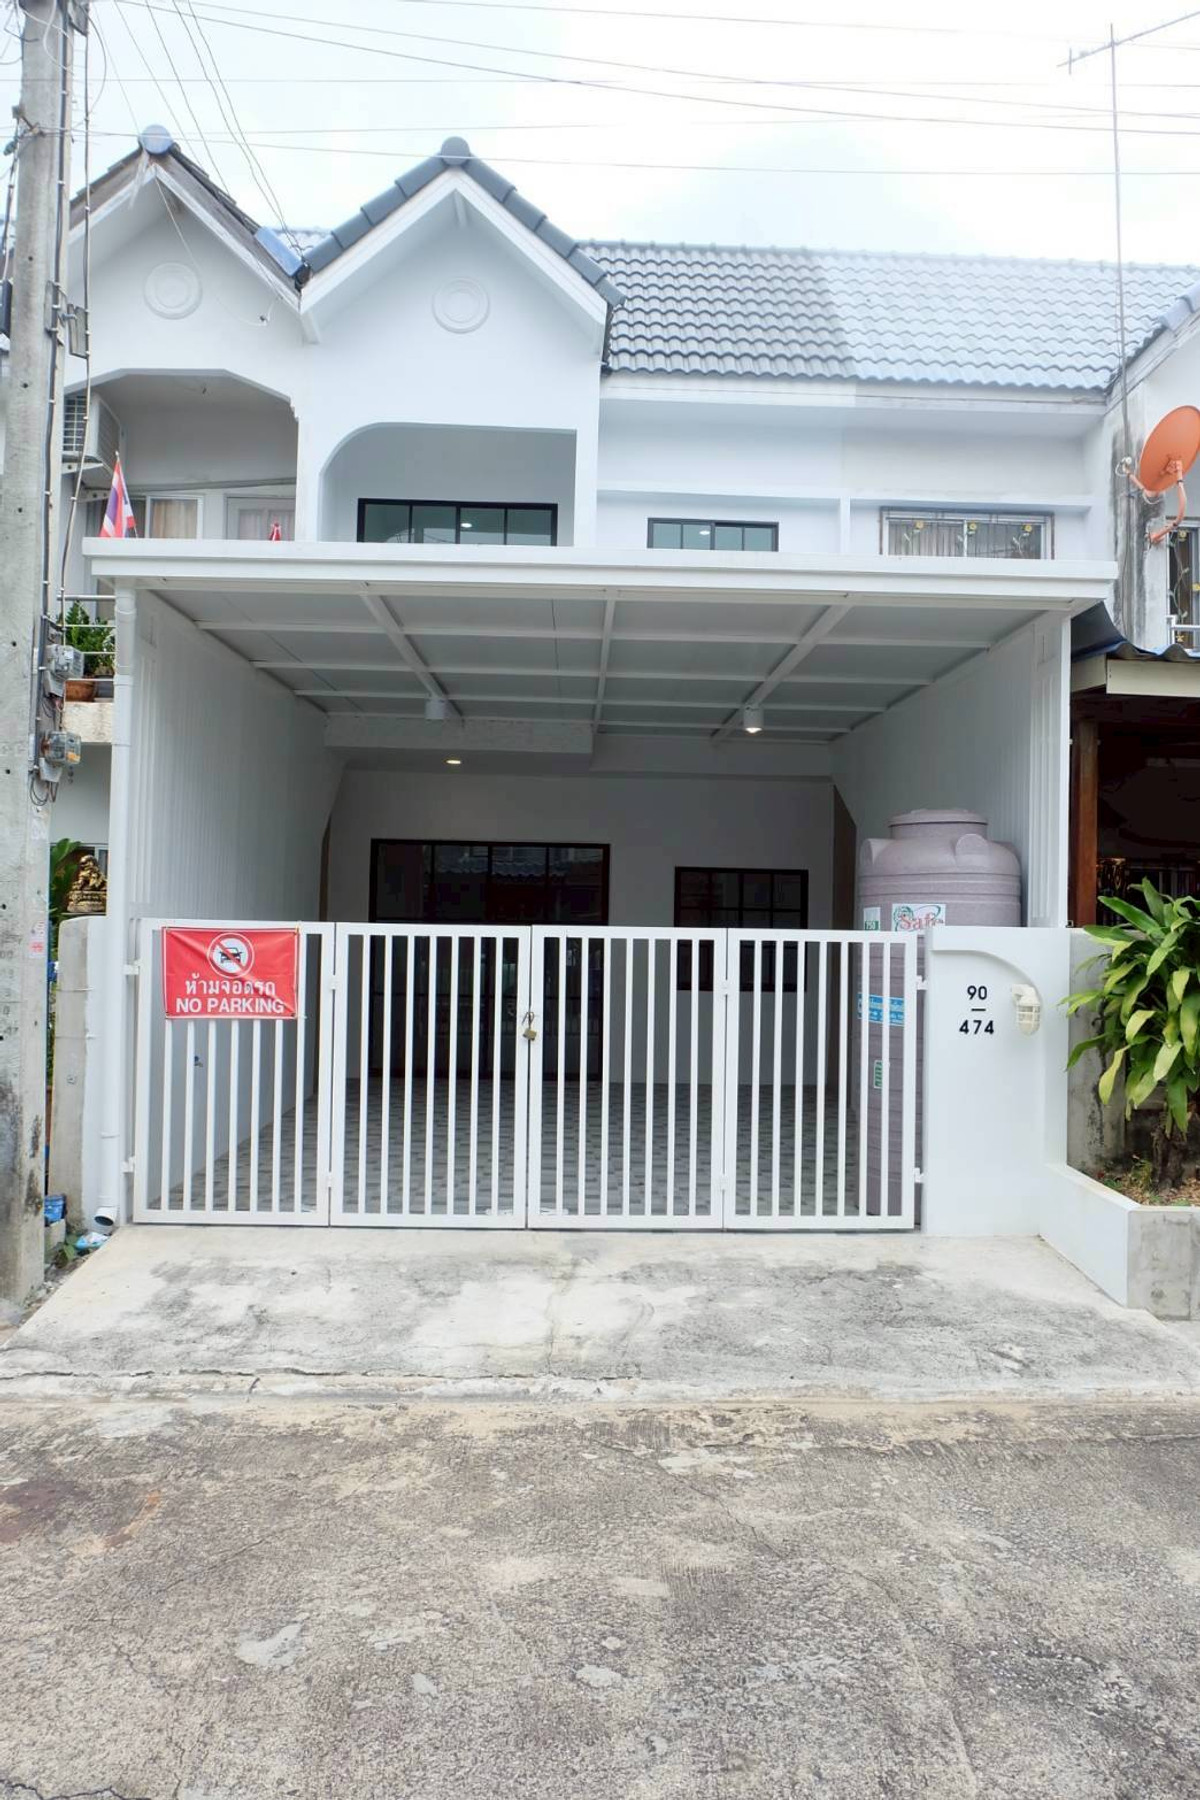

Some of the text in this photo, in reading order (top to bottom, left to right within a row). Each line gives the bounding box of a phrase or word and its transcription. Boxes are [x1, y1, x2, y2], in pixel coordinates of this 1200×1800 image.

[185, 973, 276, 996] ห้ามจอดรถ
[967, 985, 988, 1000] 90
[176, 997, 284, 1014] NO PARKING
[959, 1020, 994, 1035] 474
